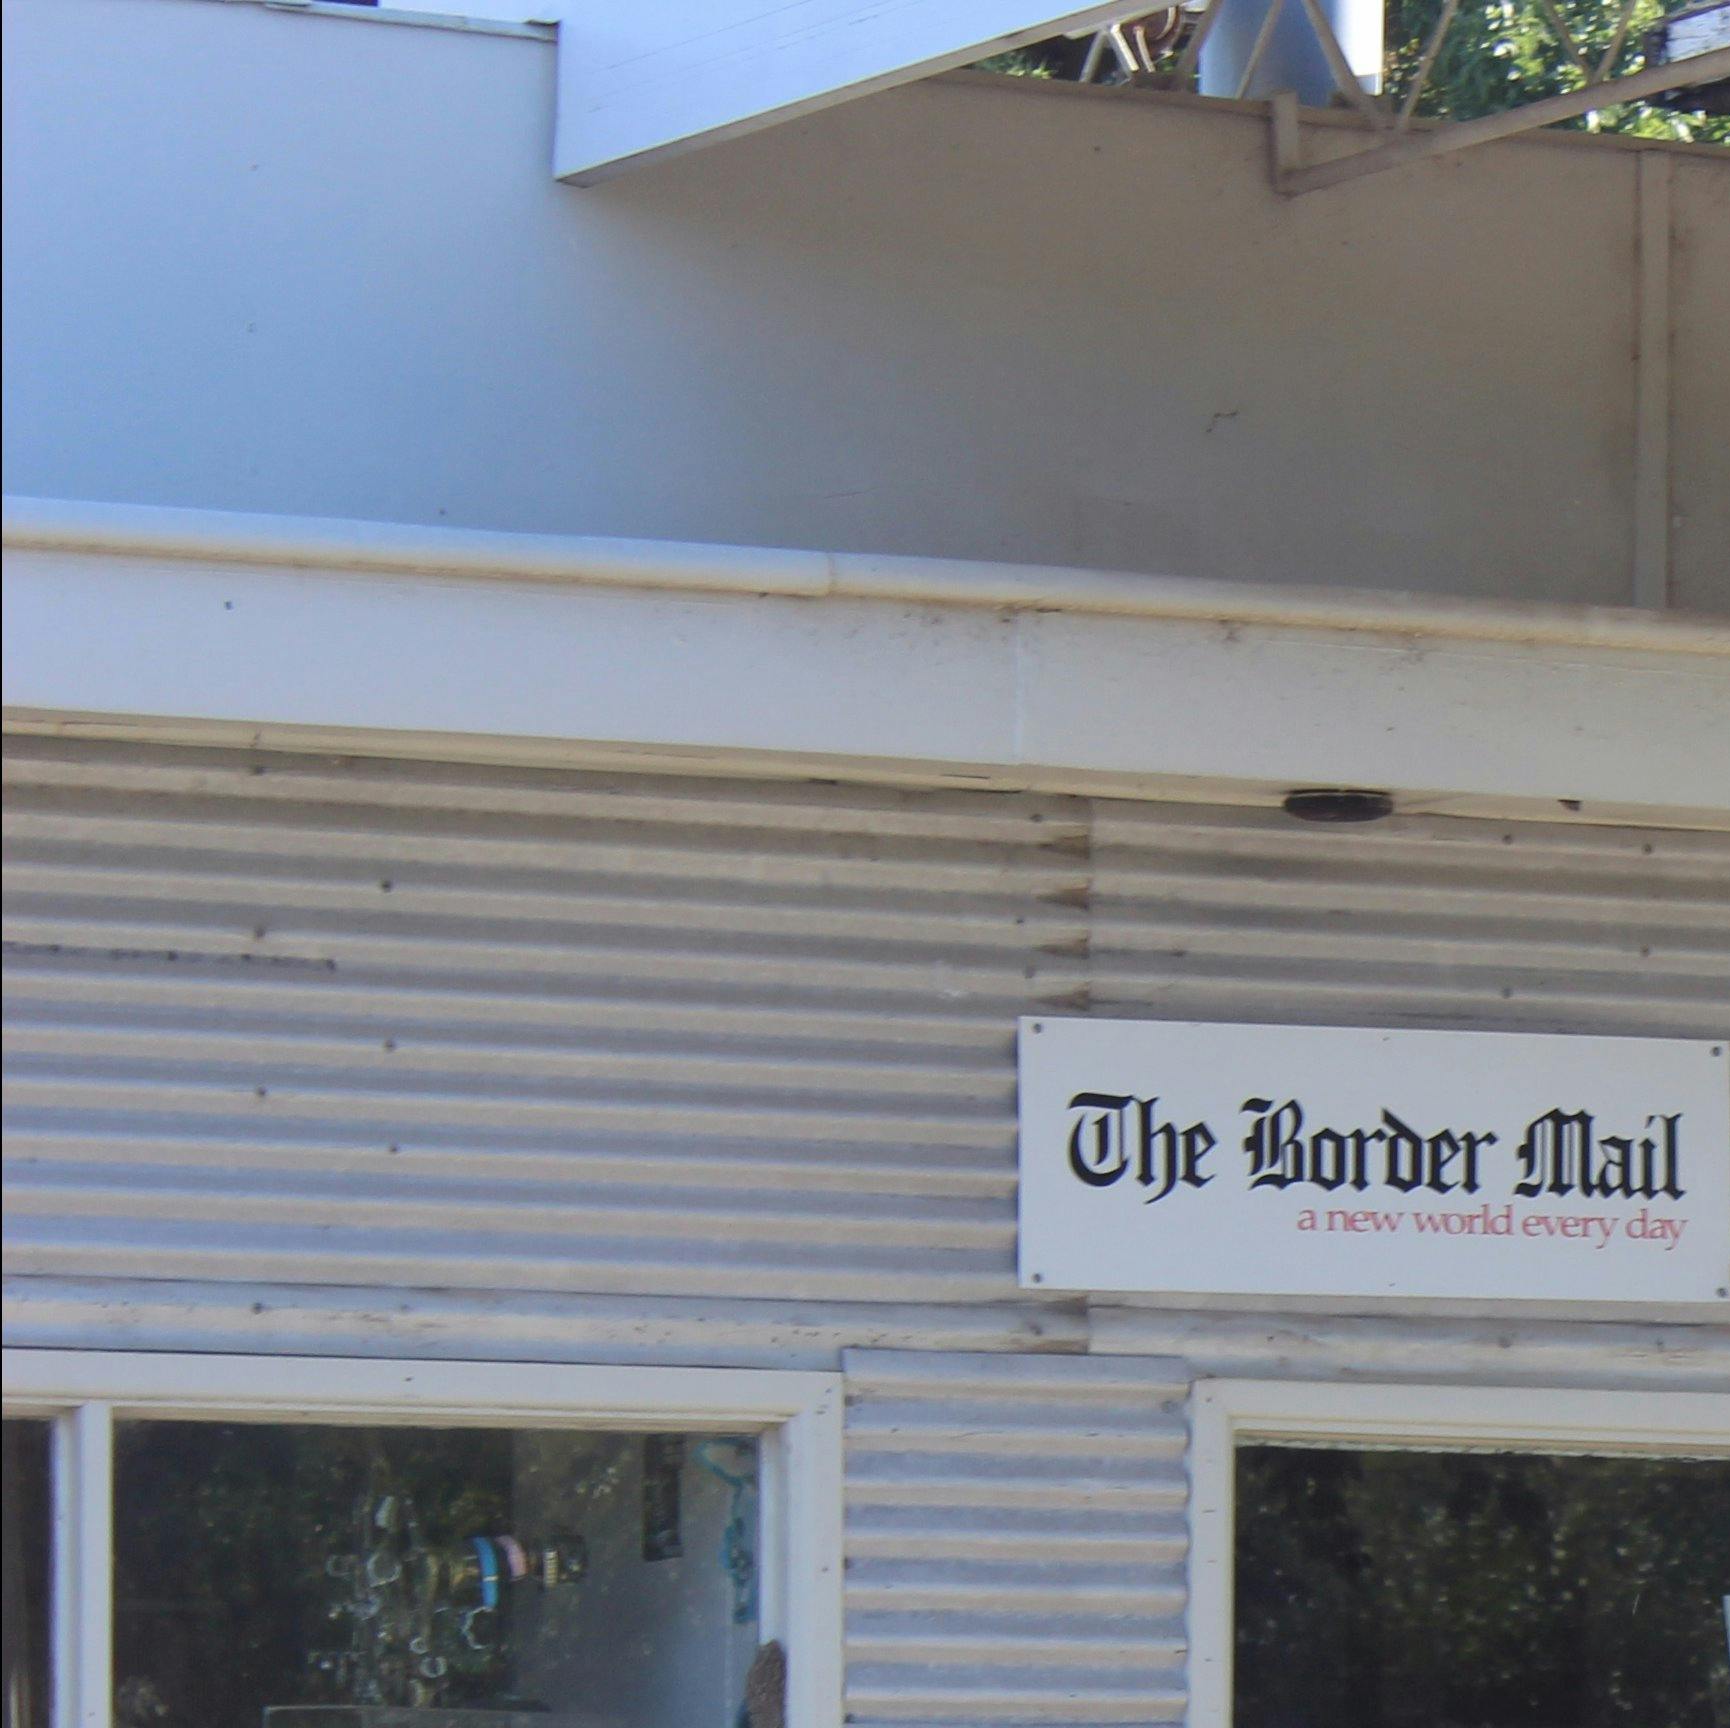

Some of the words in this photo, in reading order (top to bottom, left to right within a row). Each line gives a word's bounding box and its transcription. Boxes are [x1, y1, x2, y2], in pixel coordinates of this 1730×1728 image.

[1067, 1092, 1218, 1205] The
[1240, 1097, 1498, 1195] Border
[1513, 1107, 1687, 1200] Mail
[1297, 1208, 1315, 1232] a
[1326, 1209, 1404, 1233] new
[1413, 1203, 1514, 1236] world
[1521, 1213, 1619, 1250] every
[1625, 1208, 1689, 1251] day
